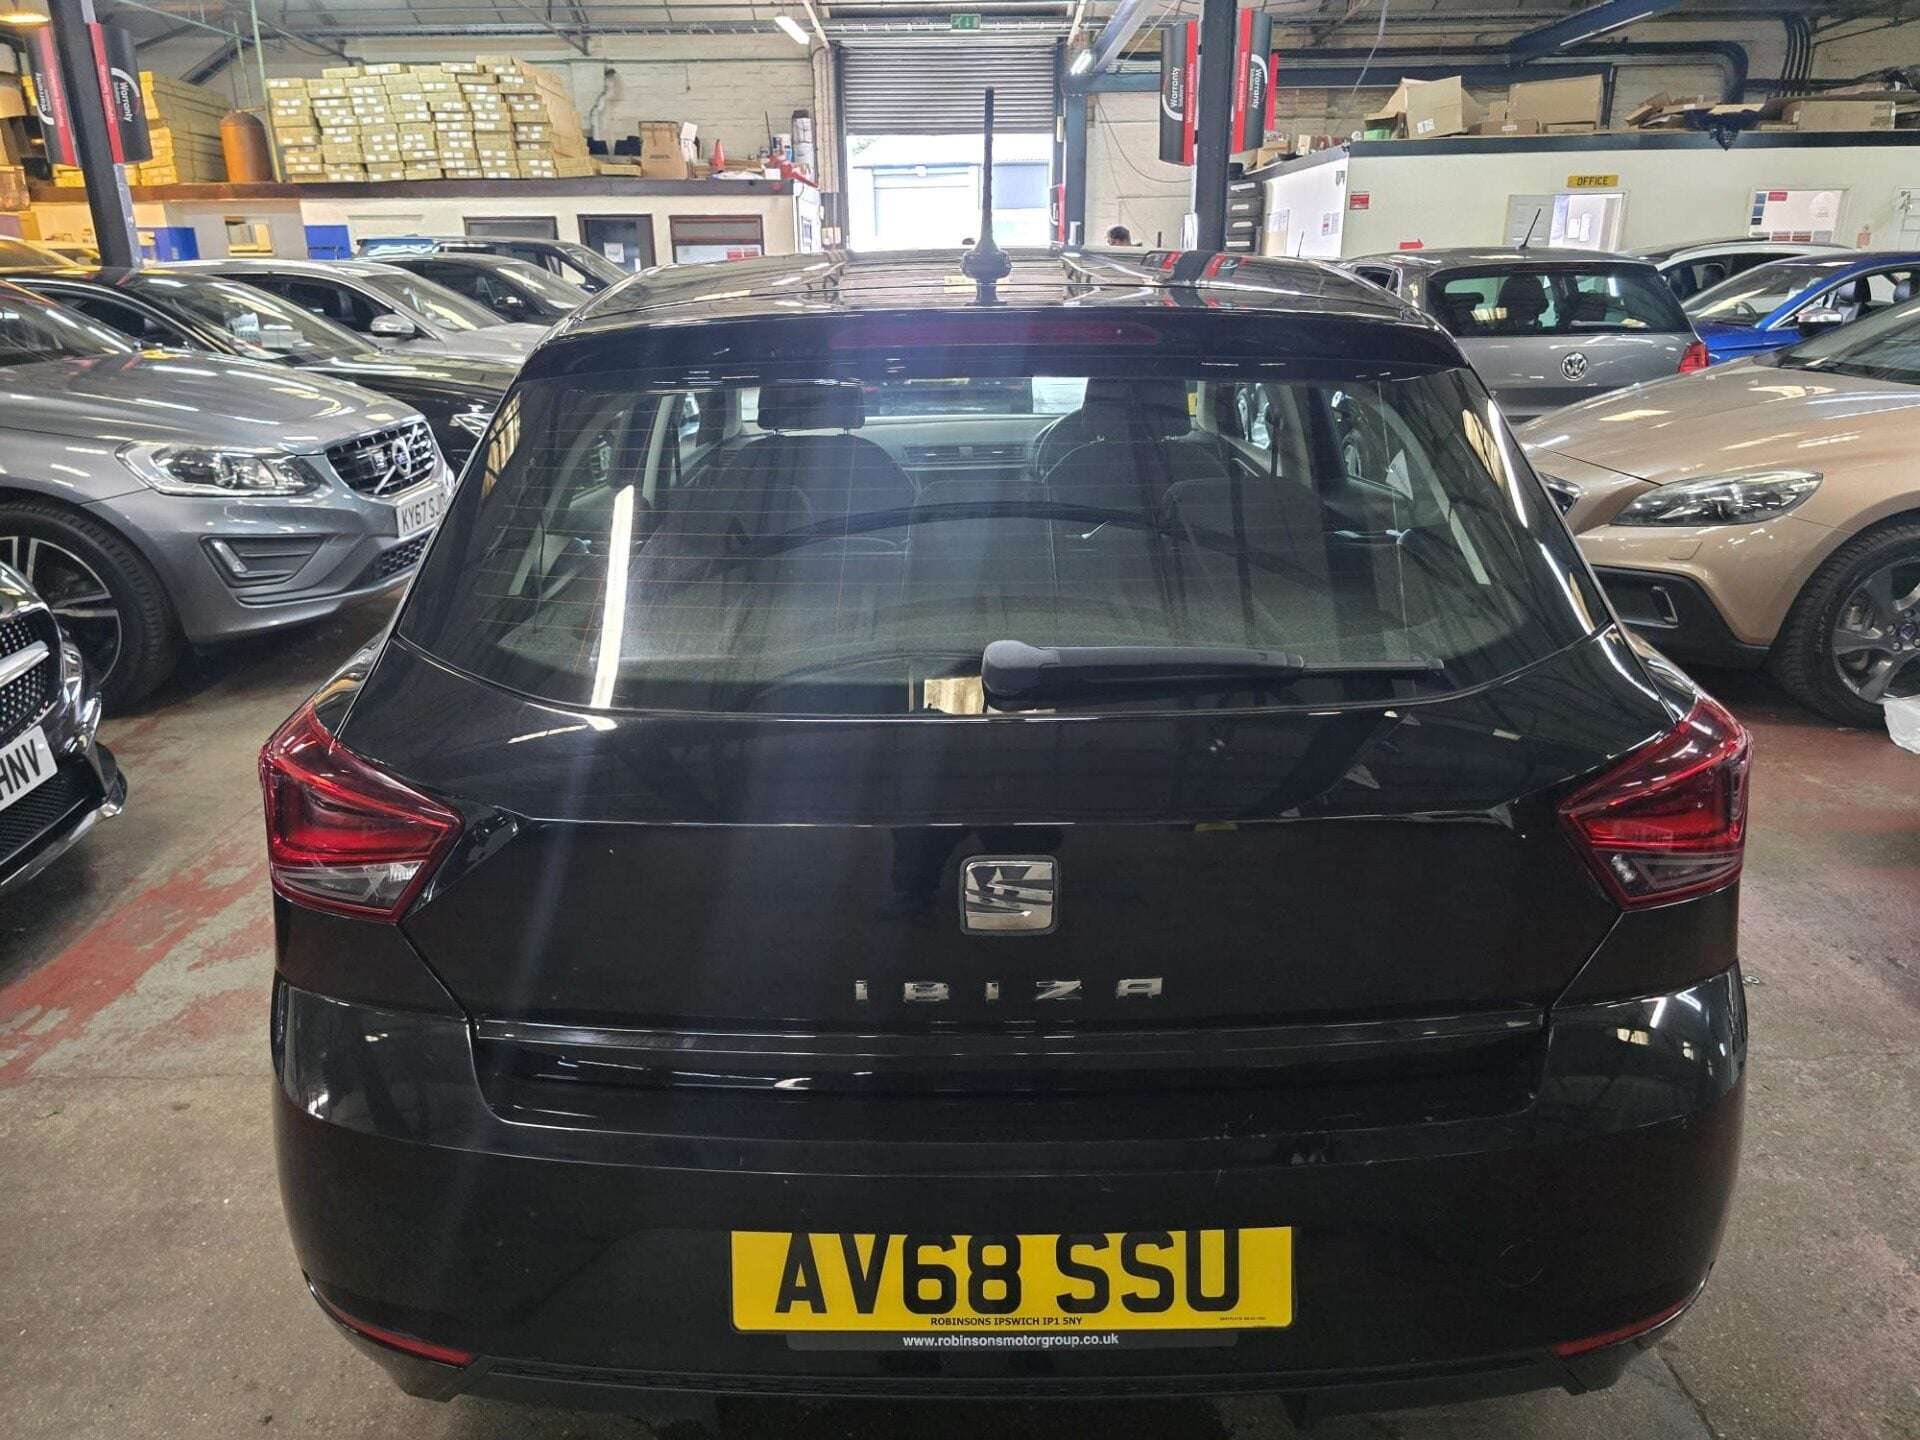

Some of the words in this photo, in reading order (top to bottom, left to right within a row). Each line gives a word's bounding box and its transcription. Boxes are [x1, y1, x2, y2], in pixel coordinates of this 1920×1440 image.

[119, 81, 133, 122] Warranty
[1170, 66, 1181, 107] Warranty
[1251, 68, 1262, 109] Warranty
[1577, 175, 1608, 186] OFFICE
[855, 977, 1163, 1001] IBIZA
[774, 1231, 1022, 1315] AV68
[1055, 1228, 1240, 1313] SSU
[930, 1317, 991, 1326] ROBINSONS
[994, 1317, 1040, 1326] IPSWICH
[1043, 1317, 1060, 1325] IP1
[1062, 1316, 1083, 1325] 5NY
[902, 1333, 1119, 1348] www.robinsonsmotorgroup.co.uk
